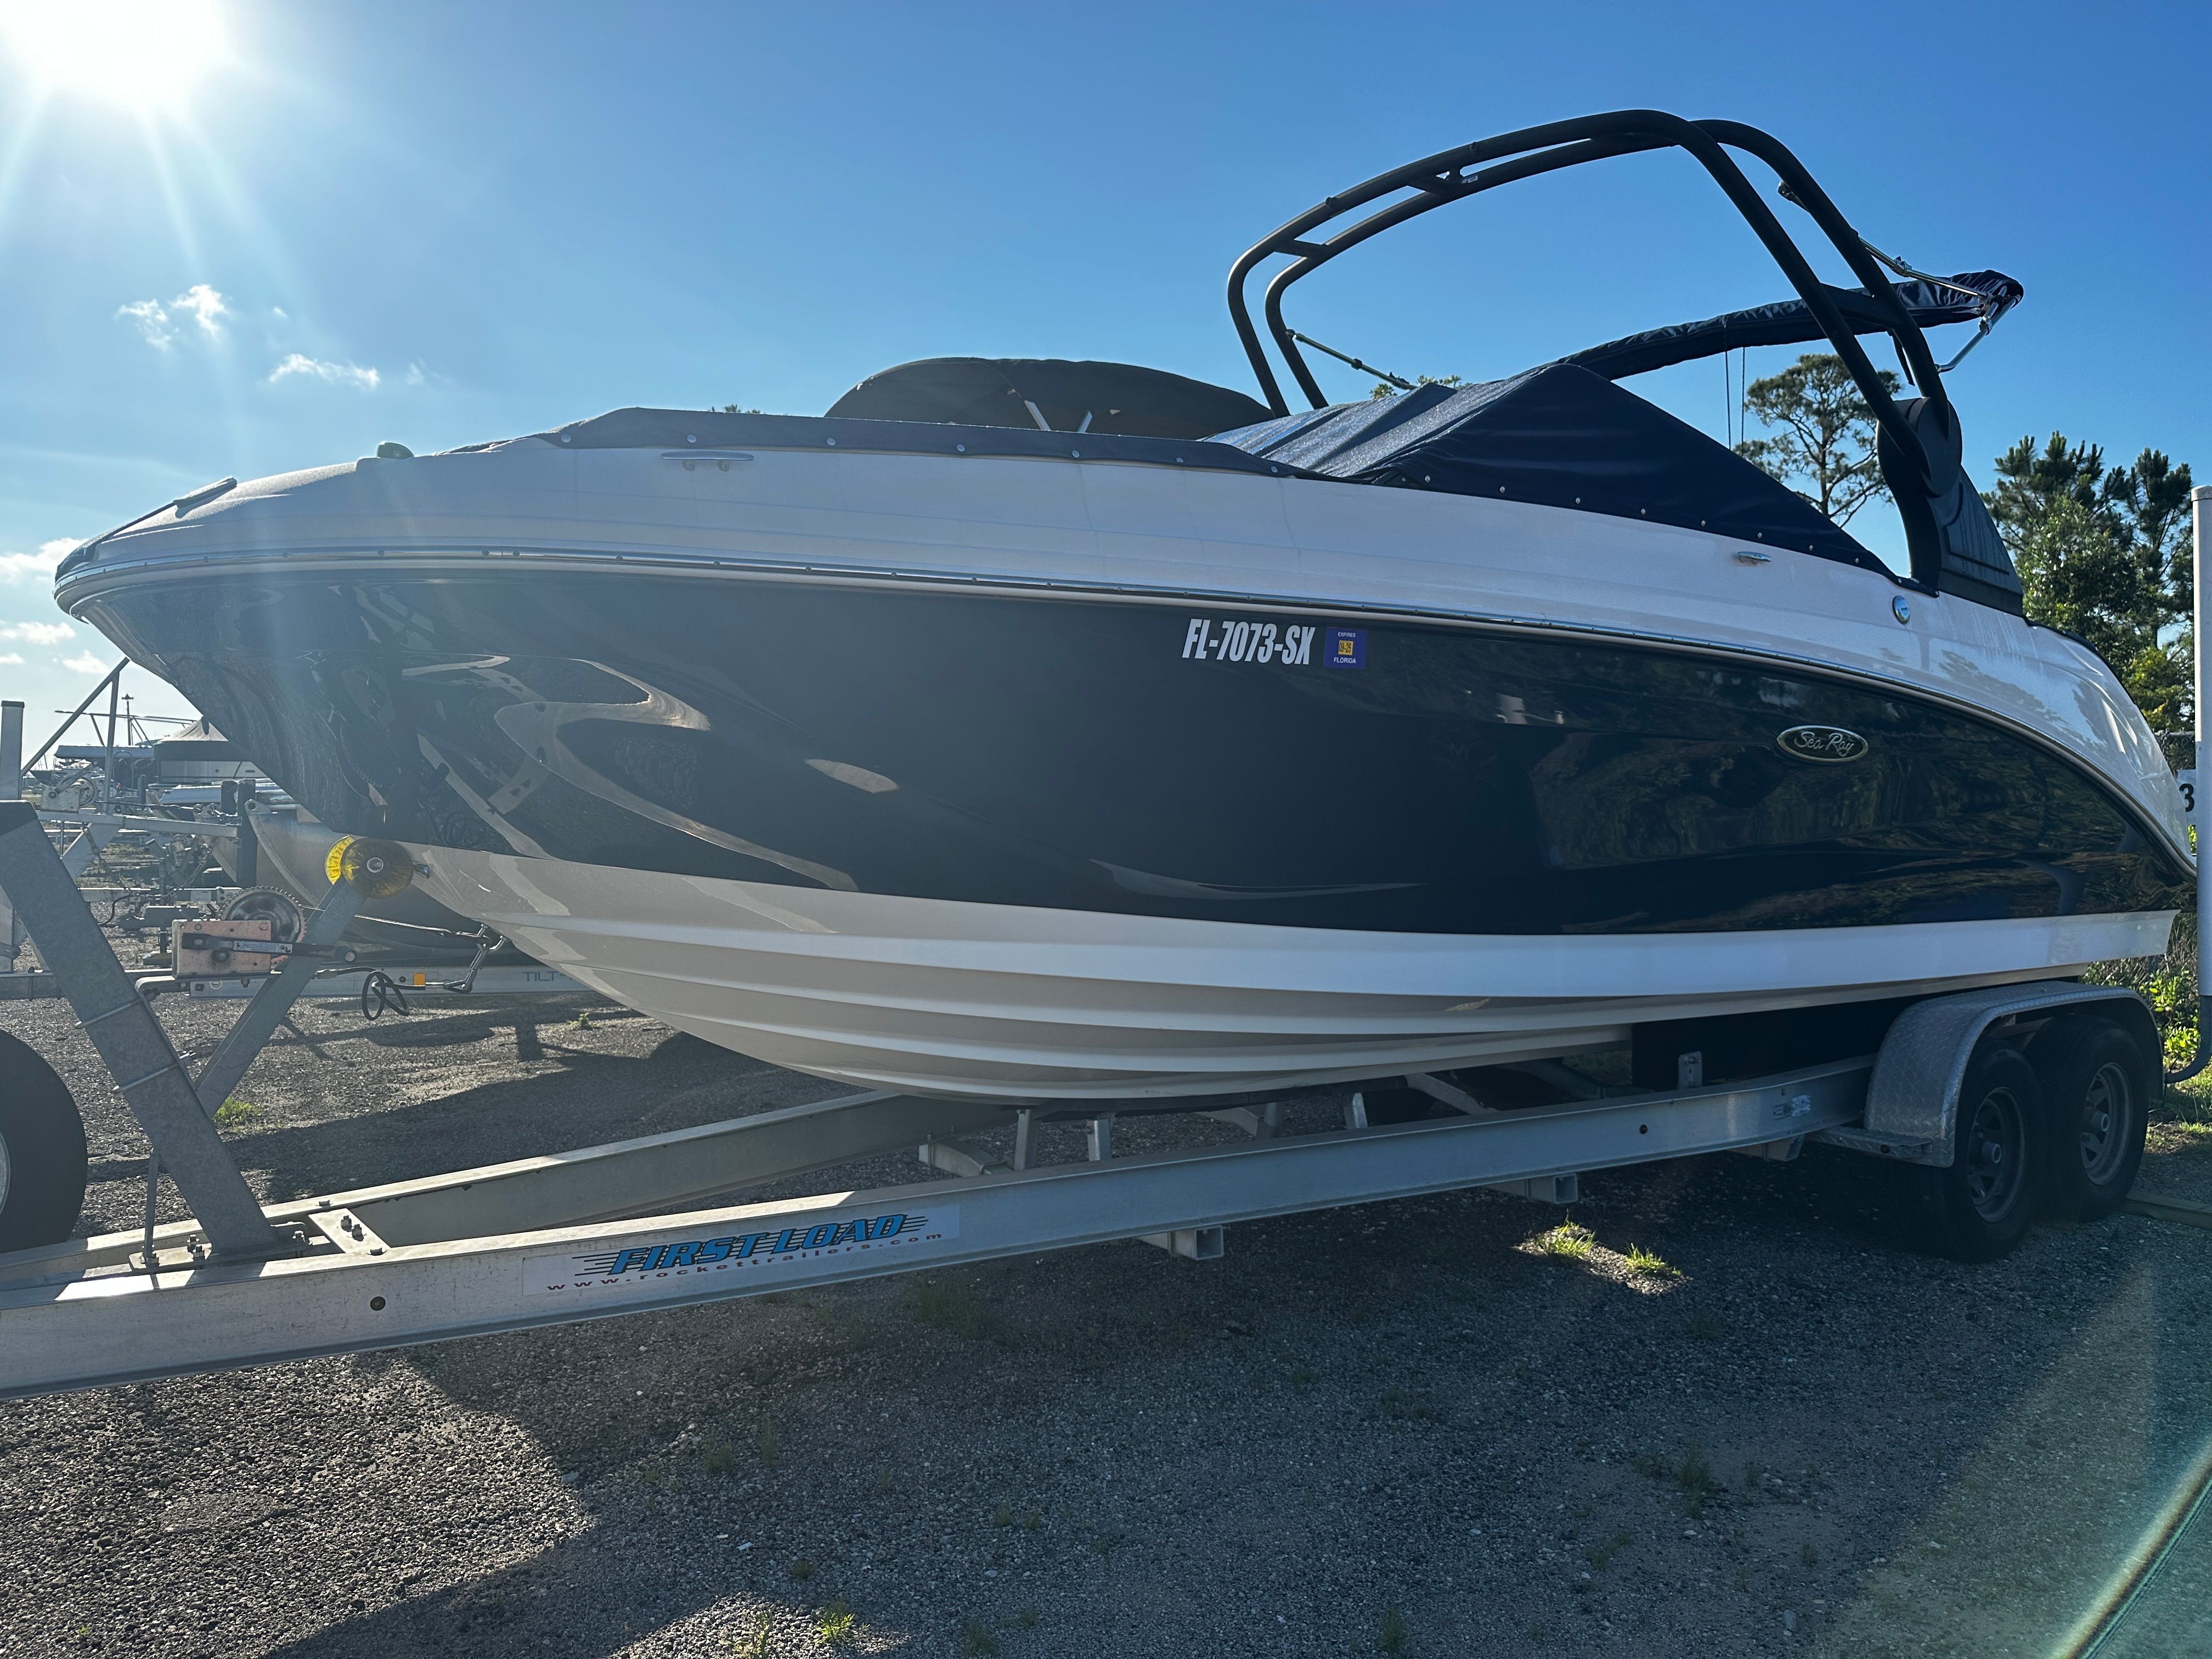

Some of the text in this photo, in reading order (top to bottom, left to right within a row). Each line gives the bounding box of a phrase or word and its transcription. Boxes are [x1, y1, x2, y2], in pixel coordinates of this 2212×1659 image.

[1182, 618, 1316, 665] FL-7073-SX
[1794, 731, 1854, 757] Sea Ray
[2179, 783, 2194, 812] 3
[547, 1233, 942, 1290] www.rockettrailers.com
[606, 1214, 908, 1276] FIRST LOAD
